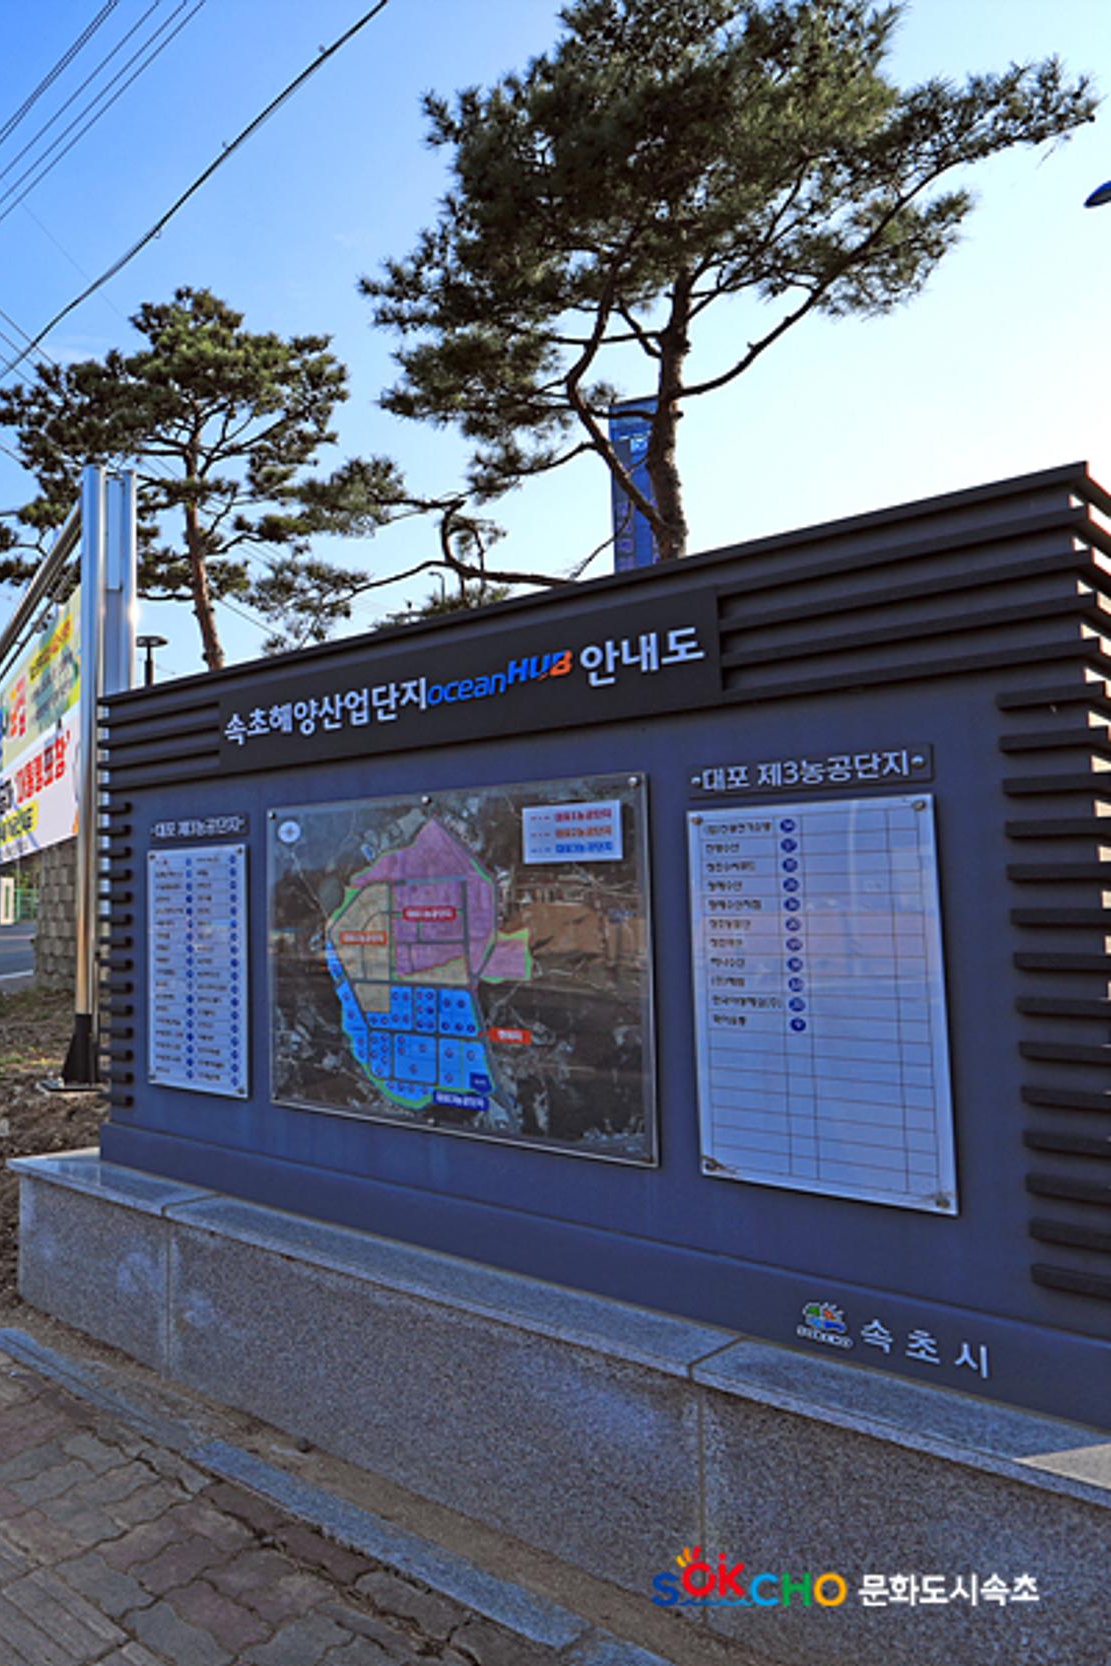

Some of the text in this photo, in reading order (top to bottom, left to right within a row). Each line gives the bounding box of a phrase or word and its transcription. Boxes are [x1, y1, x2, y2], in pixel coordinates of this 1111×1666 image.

[224, 677, 427, 745] 속초해양산업단지
[579, 626, 705, 687] 안내도
[701, 750, 909, 791] 대포 제3농공단지
[860, 1318, 988, 1379] 속초시
